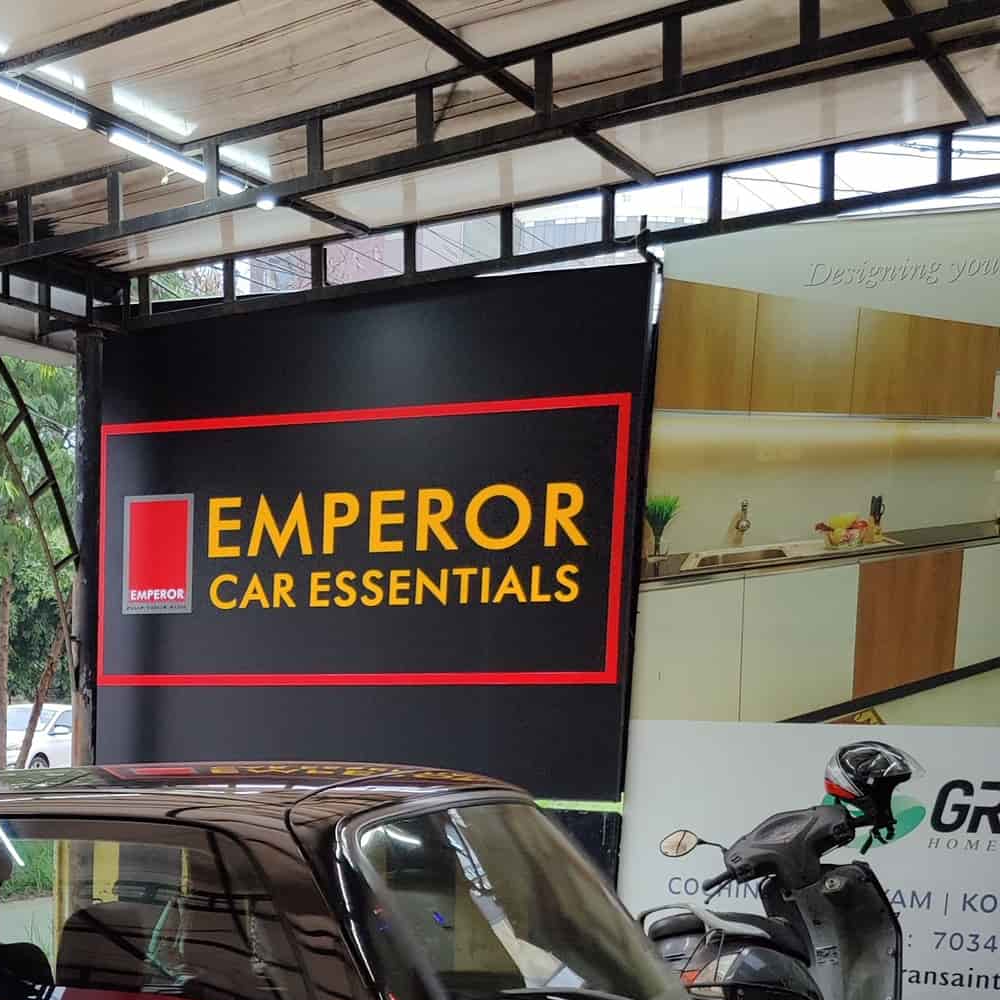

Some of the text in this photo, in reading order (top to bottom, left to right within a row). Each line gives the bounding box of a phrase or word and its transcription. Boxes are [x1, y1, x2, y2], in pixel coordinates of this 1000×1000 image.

[803, 256, 943, 289] Designing
[207, 481, 588, 559] EMPEROR
[130, 588, 185, 602] EMPEROR
[209, 563, 580, 610] CAR ESSENTIALS
[668, 876, 761, 899] COHIN
[961, 892, 999, 914] KO
[933, 931, 999, 953] 7034
